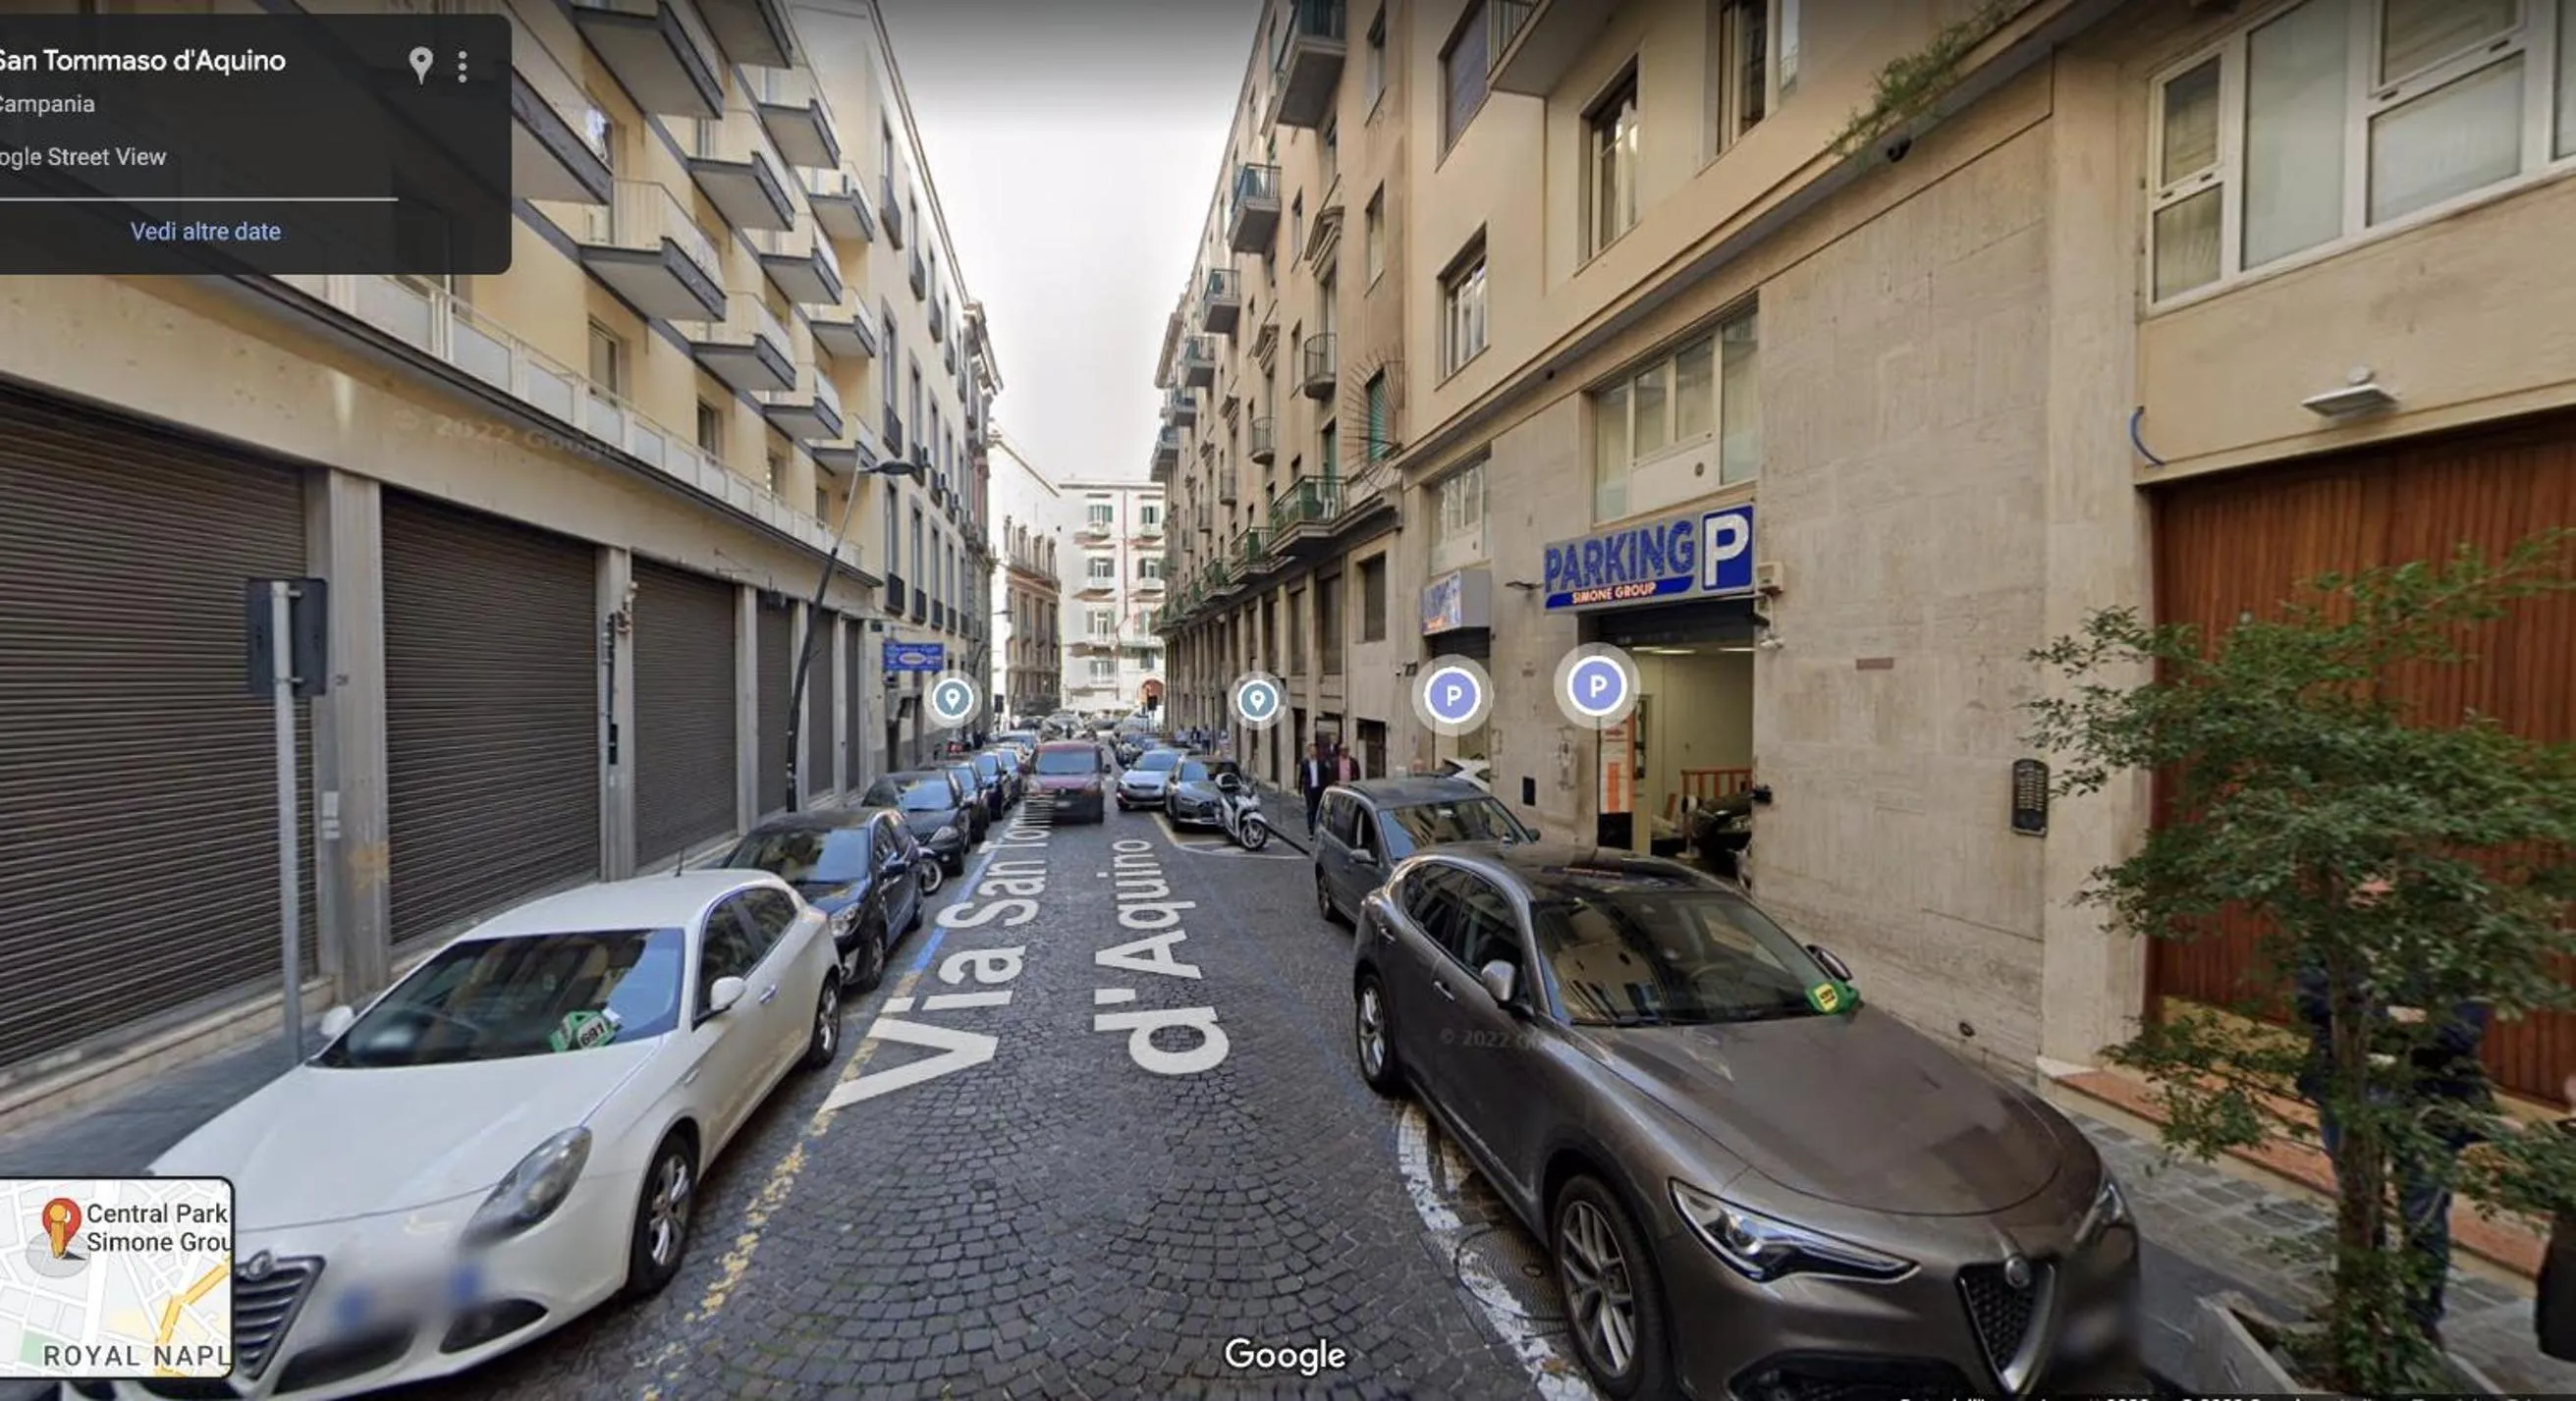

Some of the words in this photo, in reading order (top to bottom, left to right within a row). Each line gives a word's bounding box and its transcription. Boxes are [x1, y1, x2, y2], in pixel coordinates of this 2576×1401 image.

[1545, 519, 1695, 593] PARKING
[1705, 512, 1749, 587] P
[1572, 586, 1613, 605] SIMONE
[1615, 581, 1657, 599] GROUP
